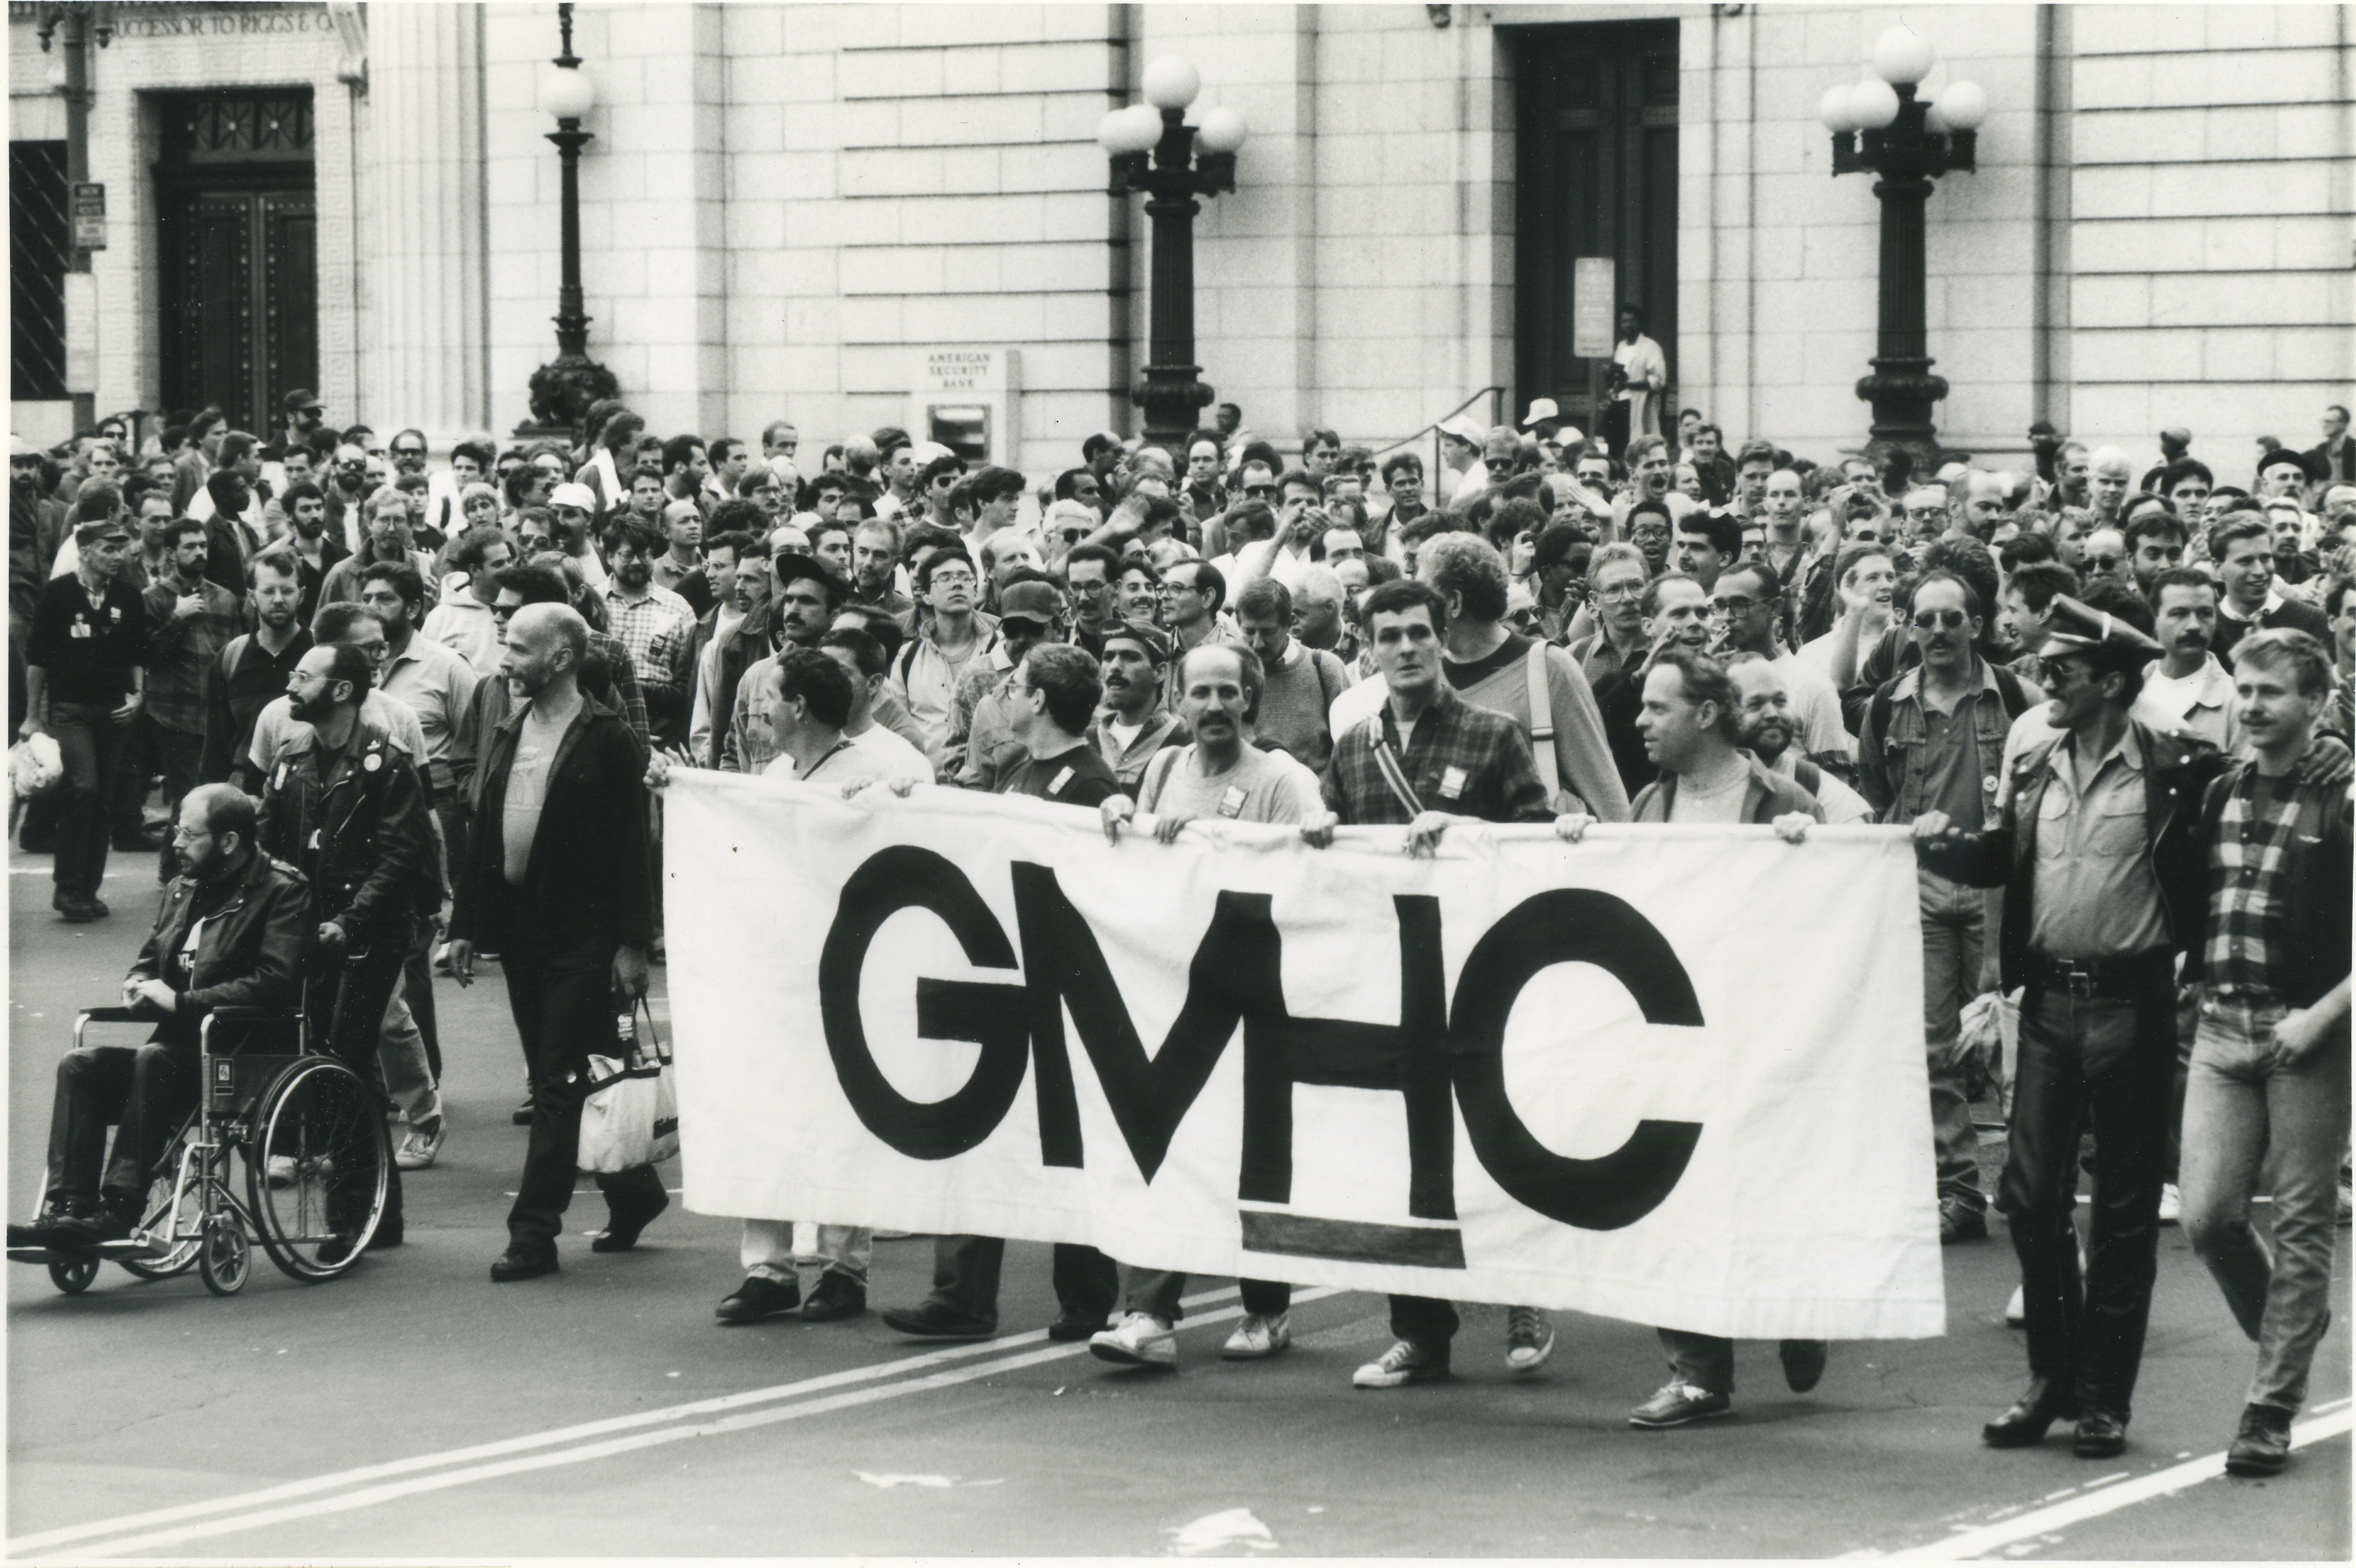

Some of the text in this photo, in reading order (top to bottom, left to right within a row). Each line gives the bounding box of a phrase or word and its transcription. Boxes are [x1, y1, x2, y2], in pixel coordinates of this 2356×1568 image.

[112, 16, 204, 37] UCCESSOR
[212, 15, 235, 35] TO
[240, 13, 292, 33] RIGGS
[928, 353, 990, 363] AMERICAN
[929, 366, 988, 376] SECURITY
[943, 379, 974, 388] BANK
[818, 844, 1705, 1230] GMHC
